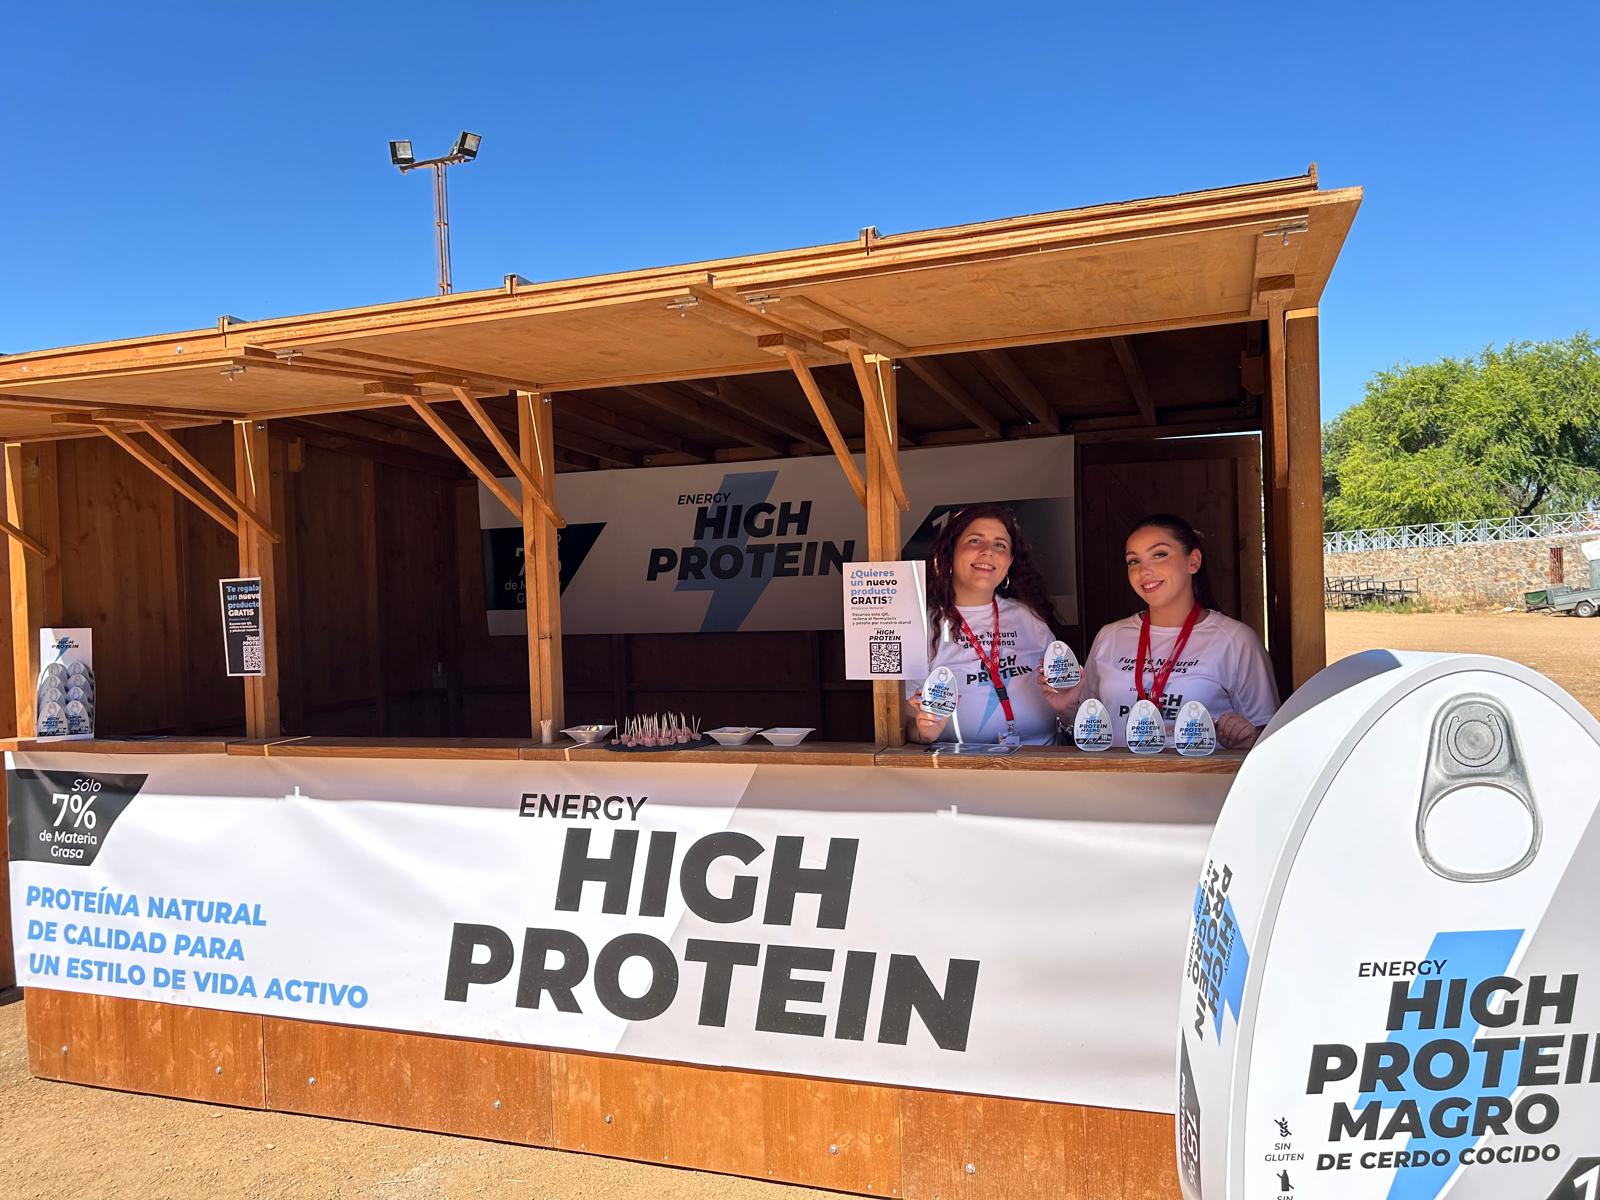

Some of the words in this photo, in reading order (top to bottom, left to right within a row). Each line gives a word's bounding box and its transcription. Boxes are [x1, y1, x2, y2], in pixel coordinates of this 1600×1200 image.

[678, 492, 731, 505] ENERGY
[693, 501, 812, 541] HIGH
[646, 540, 856, 581] PROTEIN
[850, 568, 895, 579] ¿Quieres
[850, 587, 897, 596] producto
[850, 596, 893, 605] GRATIS?
[966, 665, 1033, 685] PRTEIN
[71, 778, 102, 793] Sólo
[51, 792, 98, 830] 7%
[518, 792, 649, 822] ENERGY
[39, 829, 52, 842] de
[54, 831, 98, 845] Materia
[50, 845, 85, 859] Grasa
[554, 827, 860, 930] HIGH
[26, 885, 140, 917] PROTEÍNA
[147, 896, 267, 927] NATURAL
[27, 919, 58, 942] DE
[63, 923, 167, 954] CALIDAD
[173, 933, 246, 962] PARA
[1191, 867, 1220, 985] MAGRO
[1194, 863, 1233, 1042] PROTEIN
[1207, 910, 1234, 1018] HIGH
[1223, 926, 1237, 976] ENERGY
[1358, 959, 1447, 978] ENERGY
[29, 953, 61, 977] UN
[66, 957, 146, 987] ESTILO
[153, 967, 187, 991] DE
[193, 971, 258, 998] VIDA
[263, 977, 369, 1009] ACTIVO
[443, 922, 981, 1053] PROTEIN
[1385, 973, 1579, 1031] HIGH
[1327, 1092, 1560, 1143] MAGRO
[1264, 1153, 1305, 1162] GLUTEN
[1274, 1142, 1291, 1150] SIN
[1316, 1152, 1353, 1171] DE
[1359, 1147, 1456, 1169] CERDO
[1458, 1142, 1561, 1165] COCIDO
